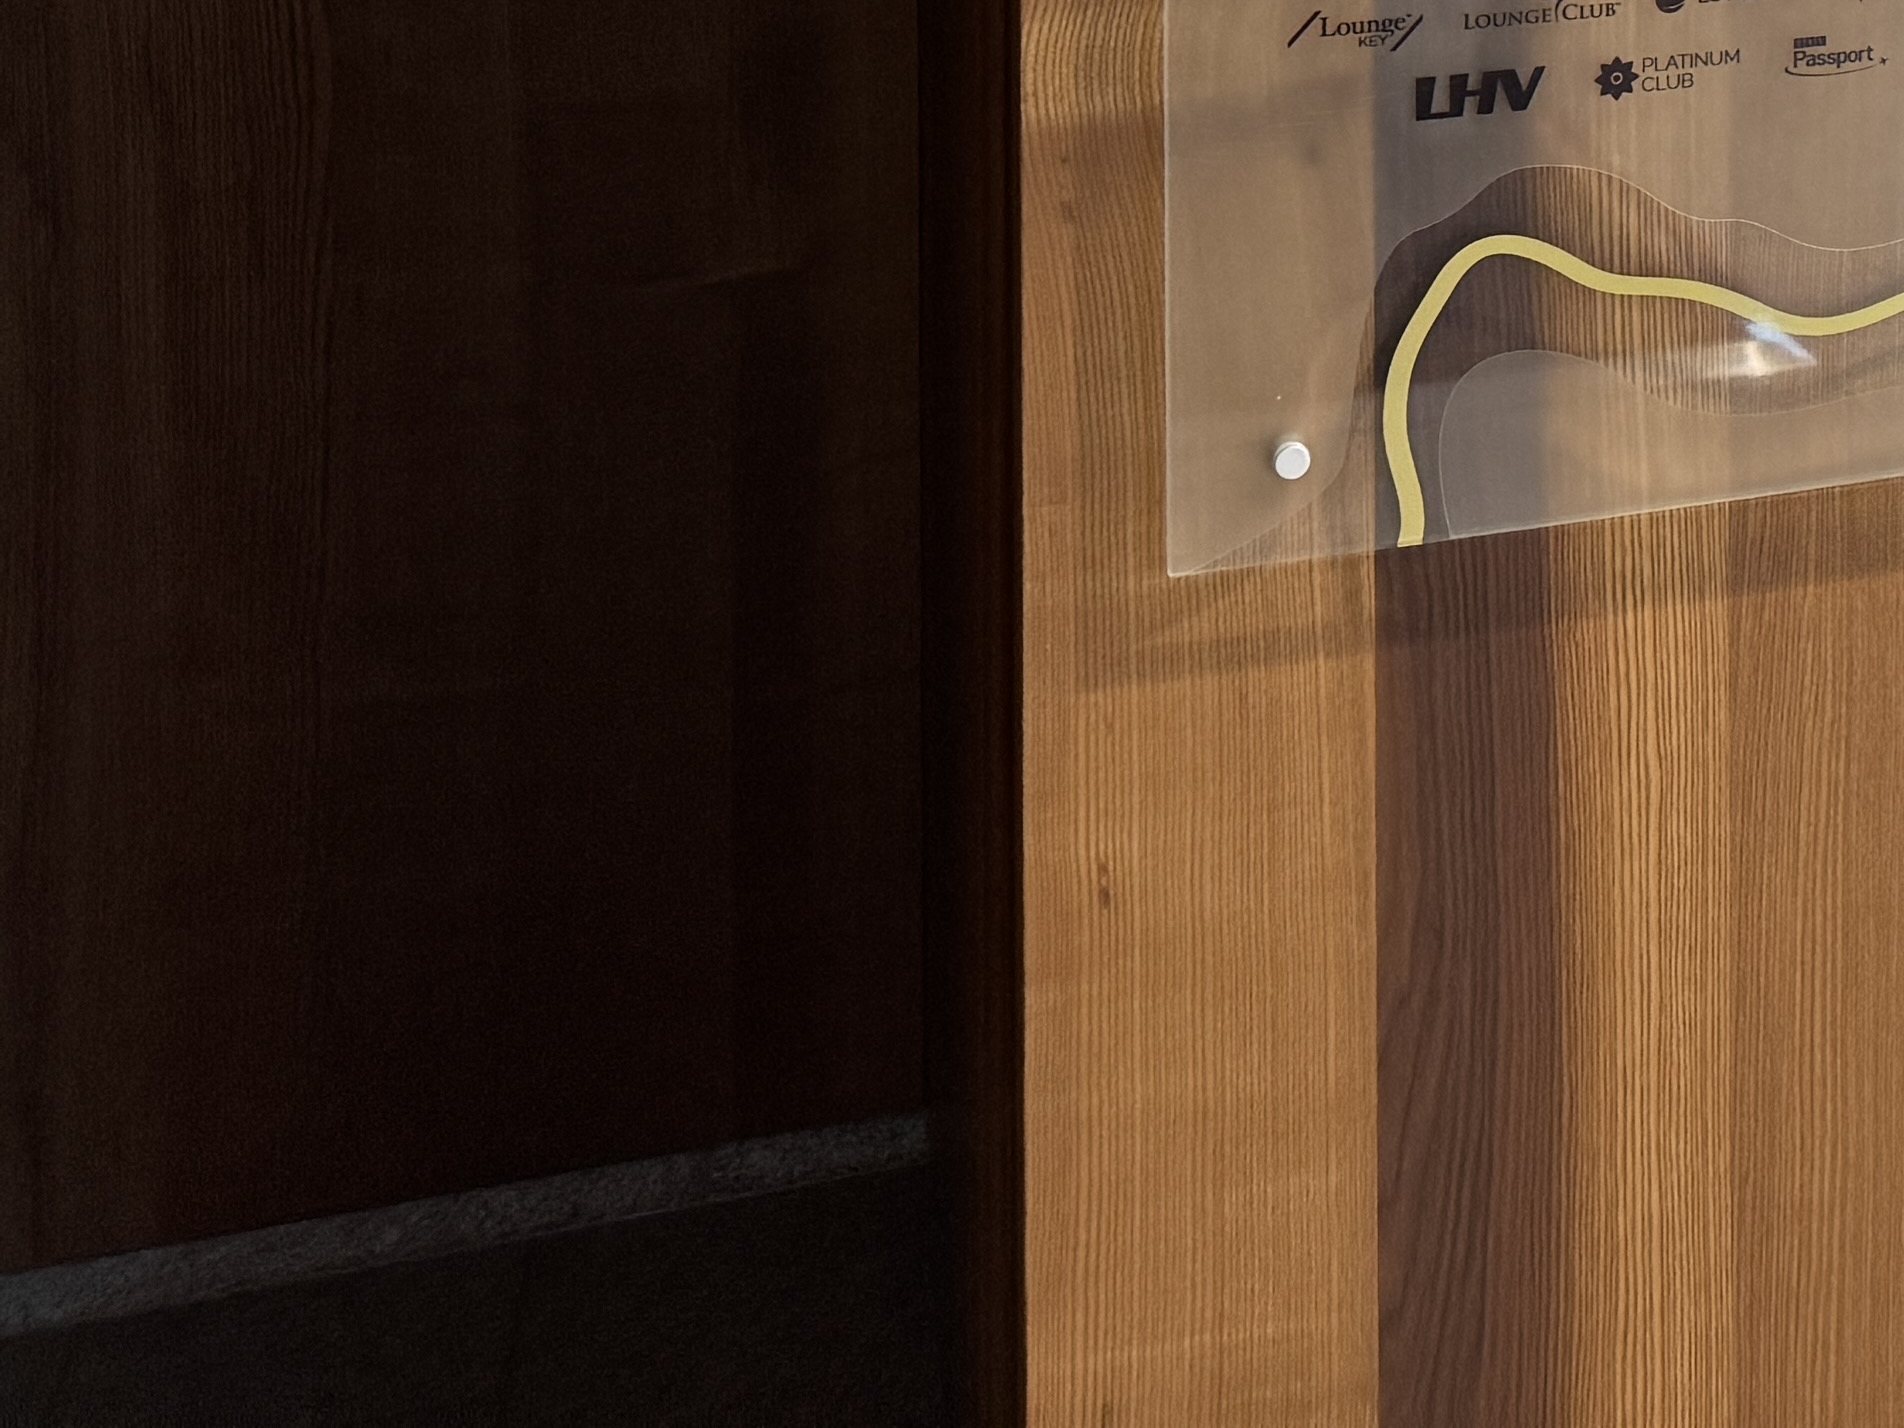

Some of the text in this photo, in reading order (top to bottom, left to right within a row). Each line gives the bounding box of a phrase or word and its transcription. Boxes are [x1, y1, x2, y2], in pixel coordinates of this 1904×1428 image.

[1319, 16, 1406, 37] Lounge
[1464, 8, 1551, 30] LOUNGE
[1358, 35, 1389, 48] KEY
[1641, 48, 1740, 72] PLATINUM
[1793, 45, 1874, 69] Passport
[1416, 66, 1545, 121] LHV
[1641, 73, 1694, 92] CLUB
